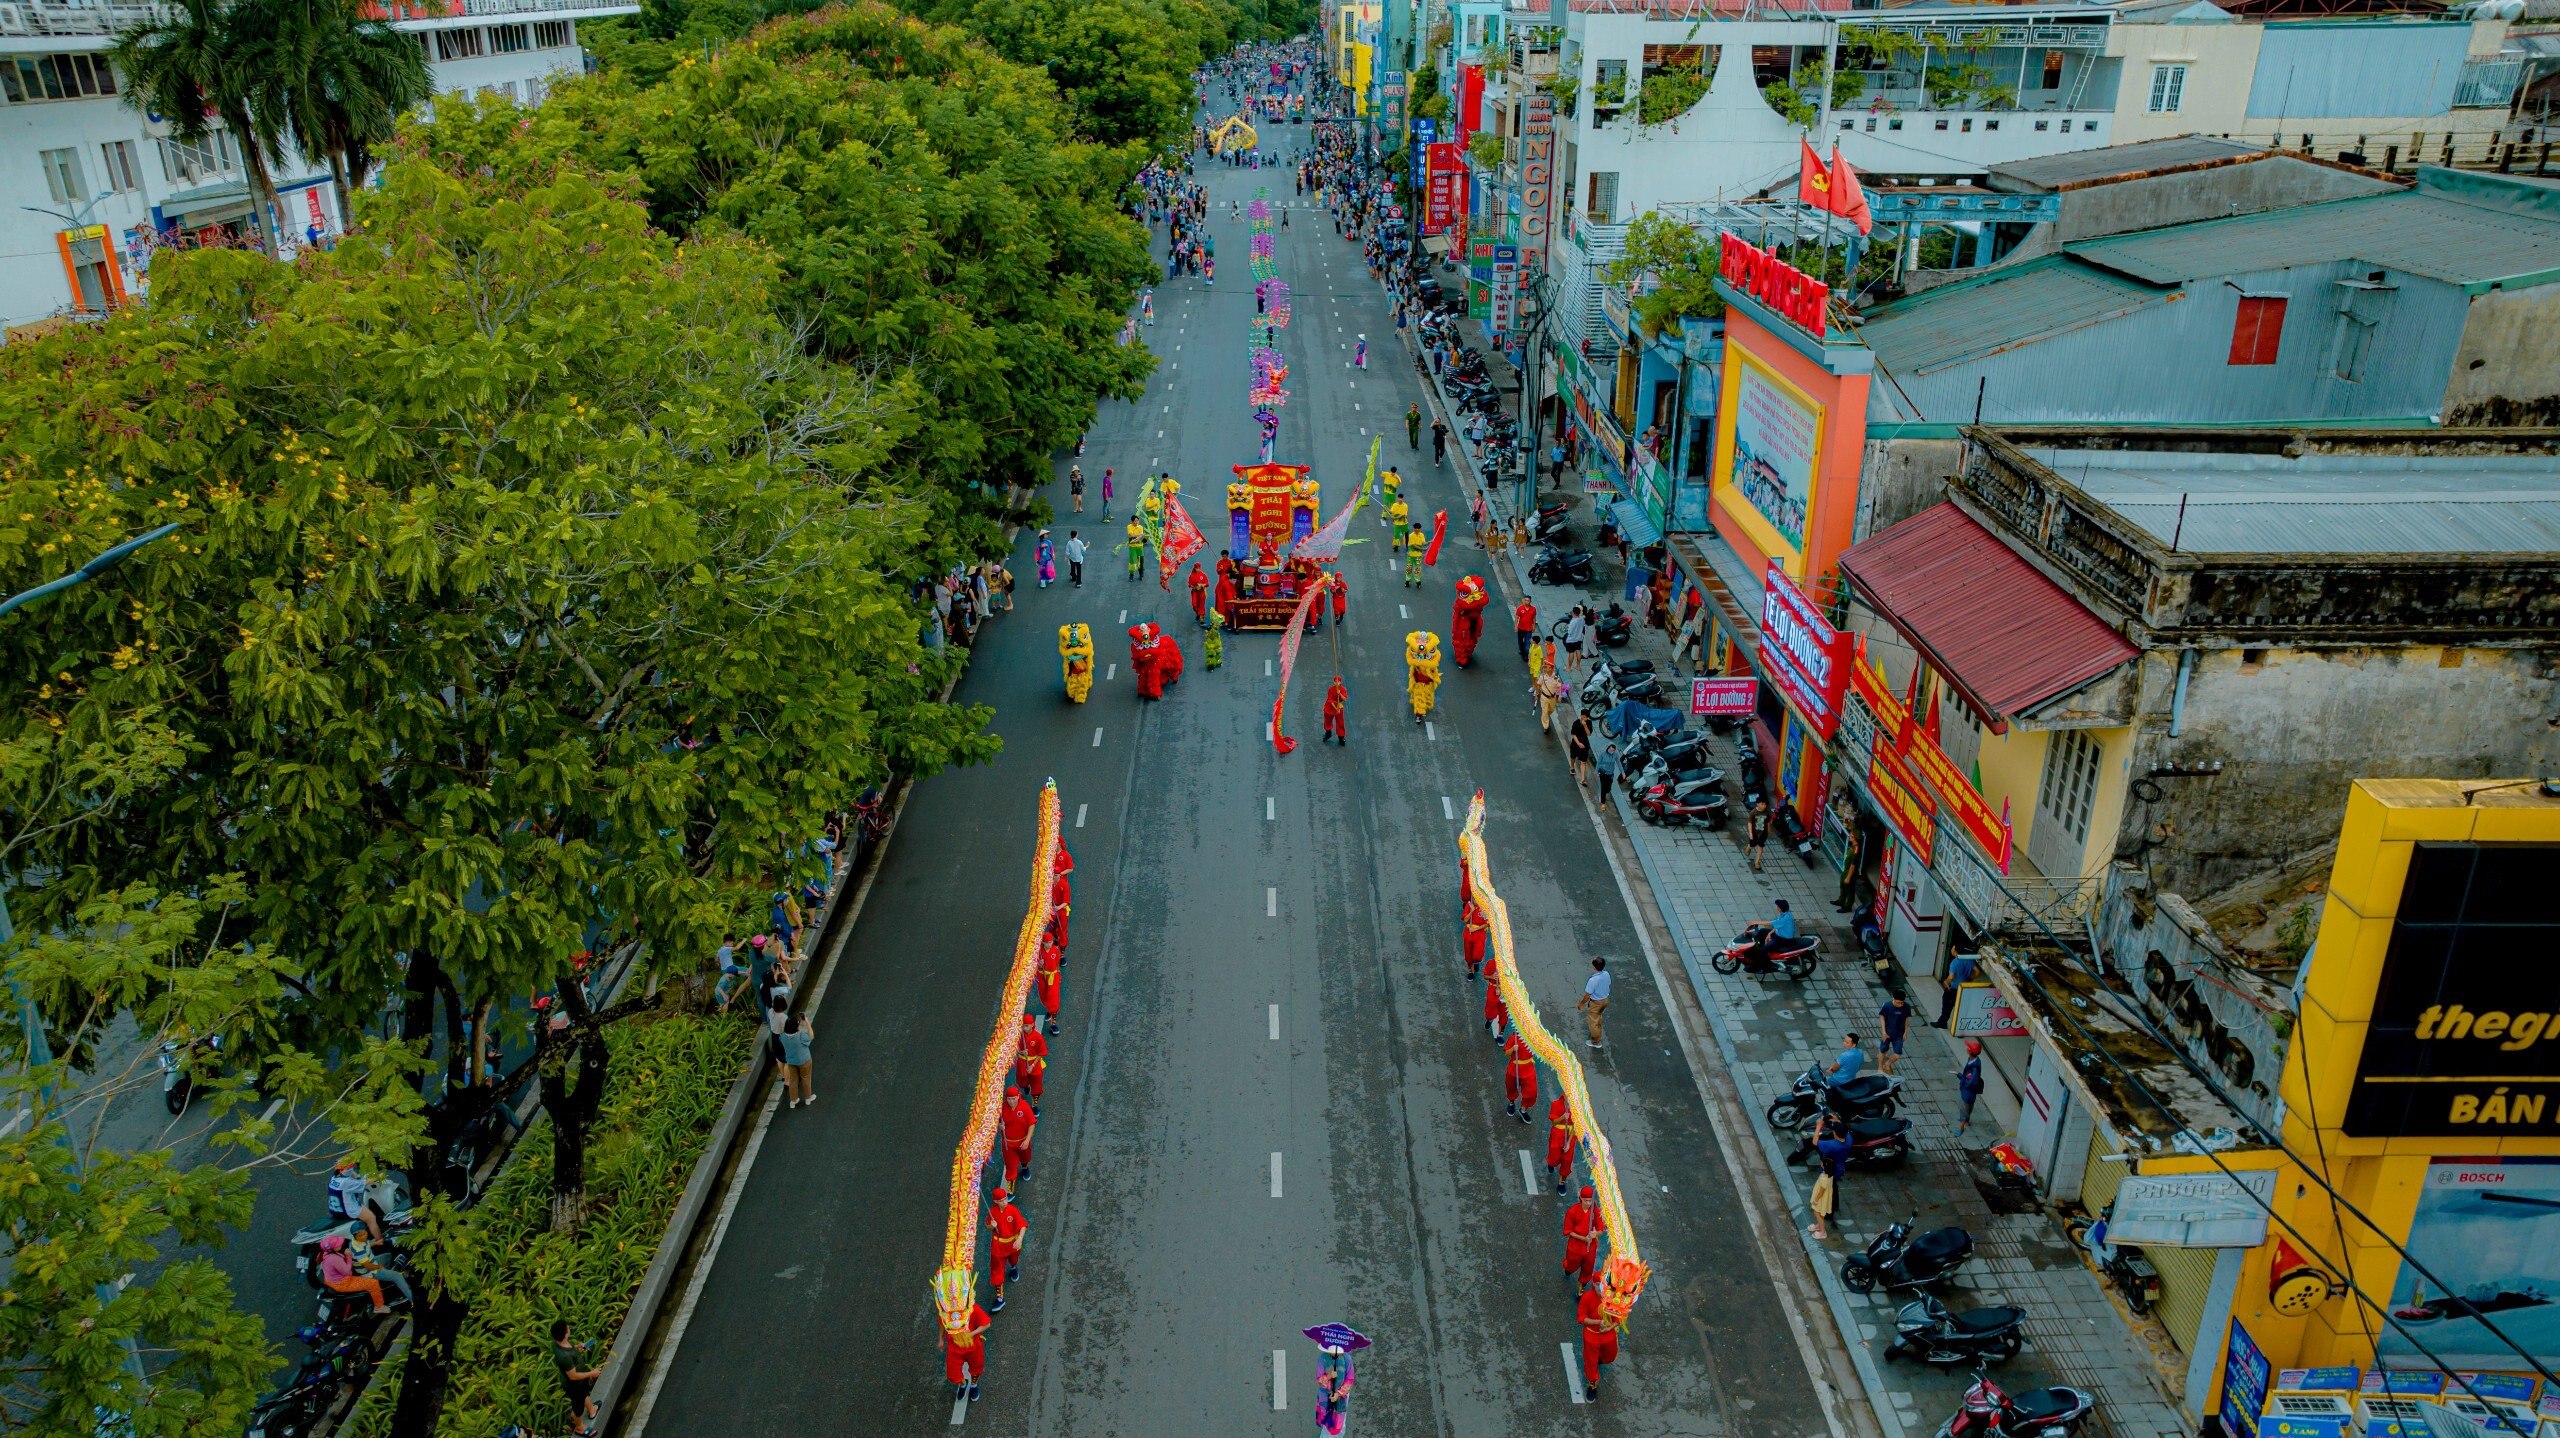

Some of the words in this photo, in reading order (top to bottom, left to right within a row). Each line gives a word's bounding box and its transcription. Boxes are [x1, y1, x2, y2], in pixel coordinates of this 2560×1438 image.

[1526, 124, 1550, 134] 9999
[1260, 496, 1282, 504] THÁI
[1766, 592, 1778, 628] TẾ
[1774, 605, 1789, 644] LỢI
[1788, 627, 1819, 681] ĐƯỜNG
[1818, 656, 1828, 688] 2
[1696, 690, 1705, 706] TẾ
[1706, 692, 1718, 709] LỢI
[1720, 690, 1746, 706] ĐƯỜNG
[1747, 693, 1753, 706] 2
[1959, 1013, 1992, 1030] TRẢ
[2448, 1086, 2546, 1124] BÁN
[2459, 1173, 2506, 1183] BOSCH
